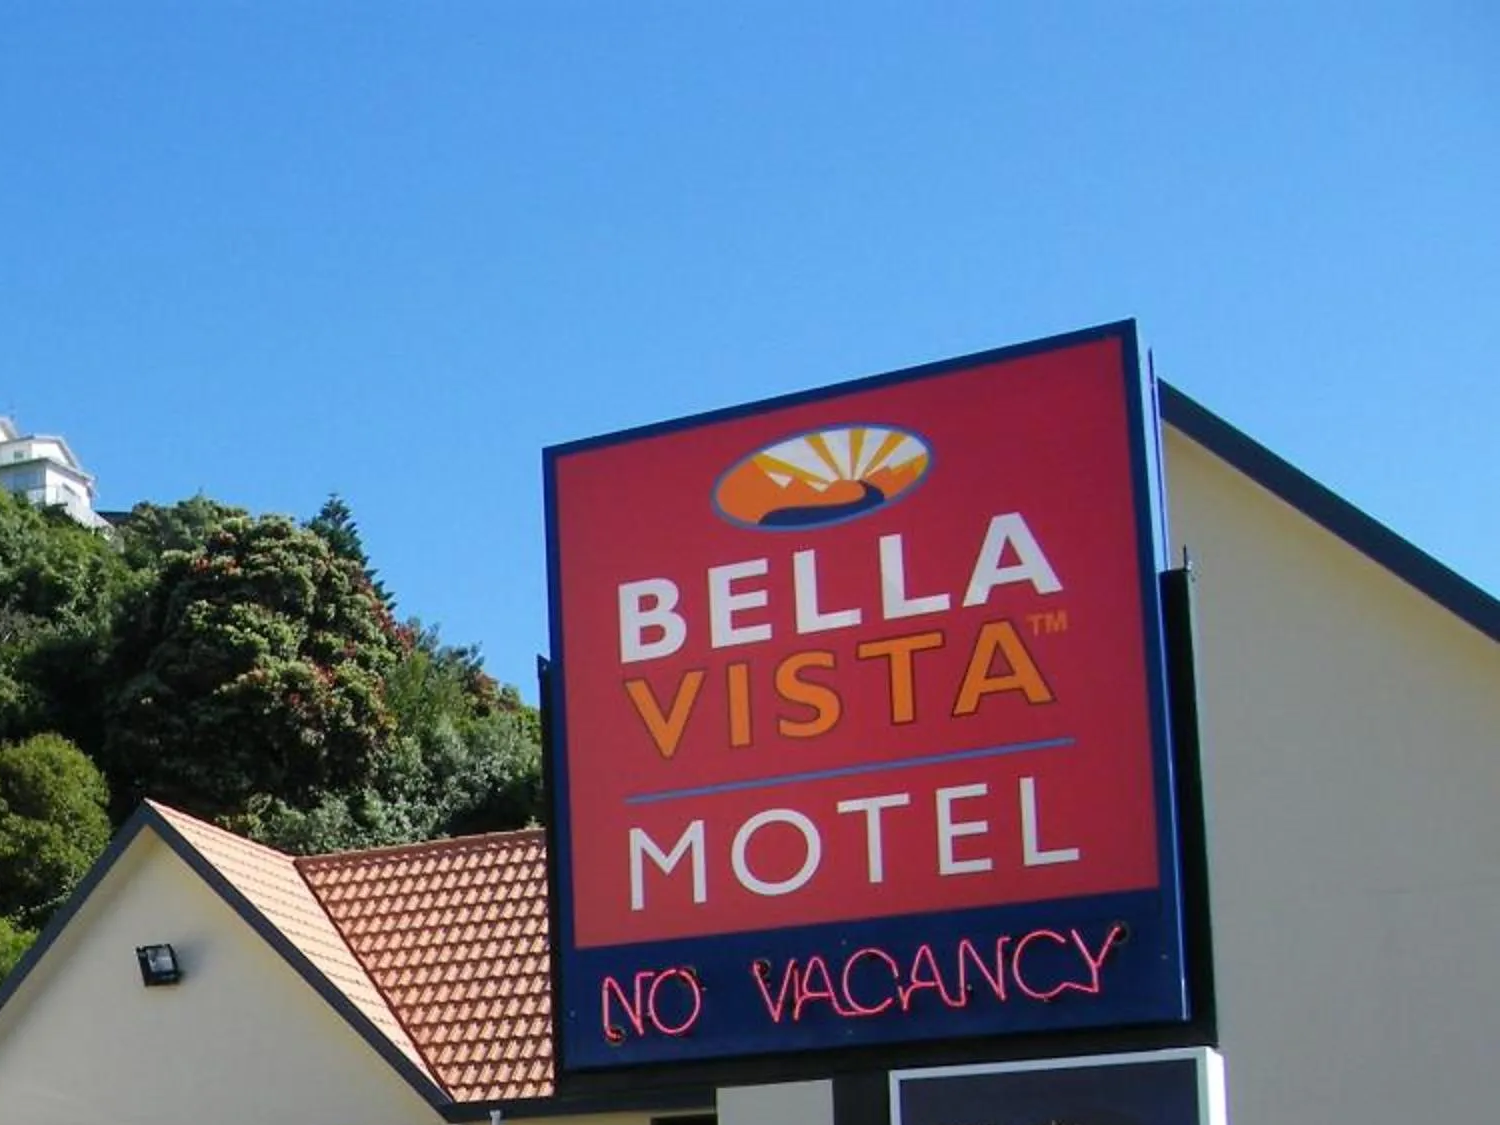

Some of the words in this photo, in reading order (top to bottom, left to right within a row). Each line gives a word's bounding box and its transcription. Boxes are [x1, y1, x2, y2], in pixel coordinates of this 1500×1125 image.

[618, 512, 1063, 664] BELLA
[624, 620, 1056, 760] VISTA
[1026, 611, 1069, 637] TM
[629, 777, 1080, 911] MOTEL
[603, 968, 700, 1036] NO
[755, 926, 1124, 1022] VACANCY
